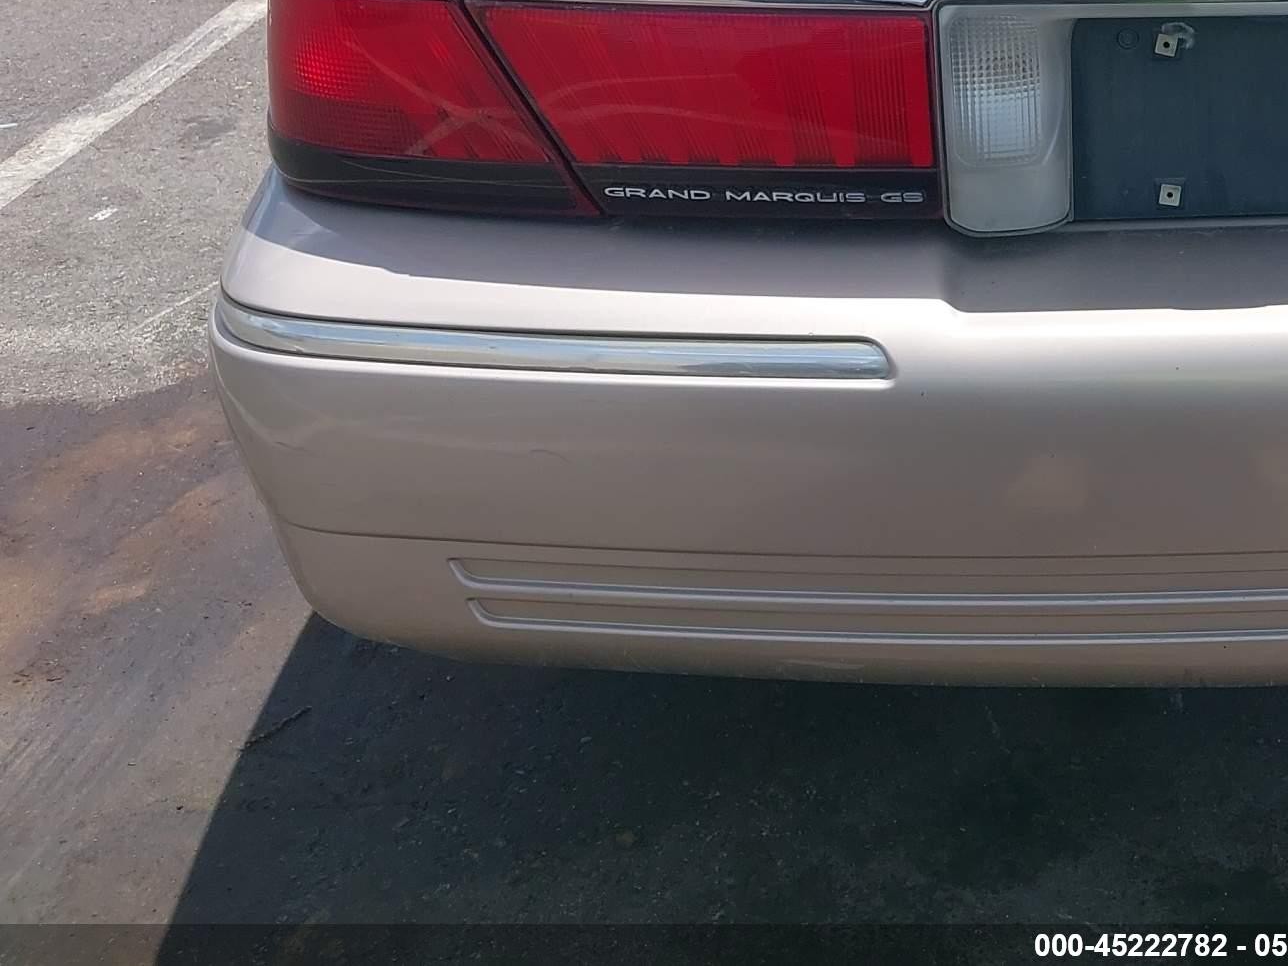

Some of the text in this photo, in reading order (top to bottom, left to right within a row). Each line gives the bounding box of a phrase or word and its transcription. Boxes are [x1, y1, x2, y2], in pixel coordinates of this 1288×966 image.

[604, 187, 924, 203] GRAND MARQUIS GS
